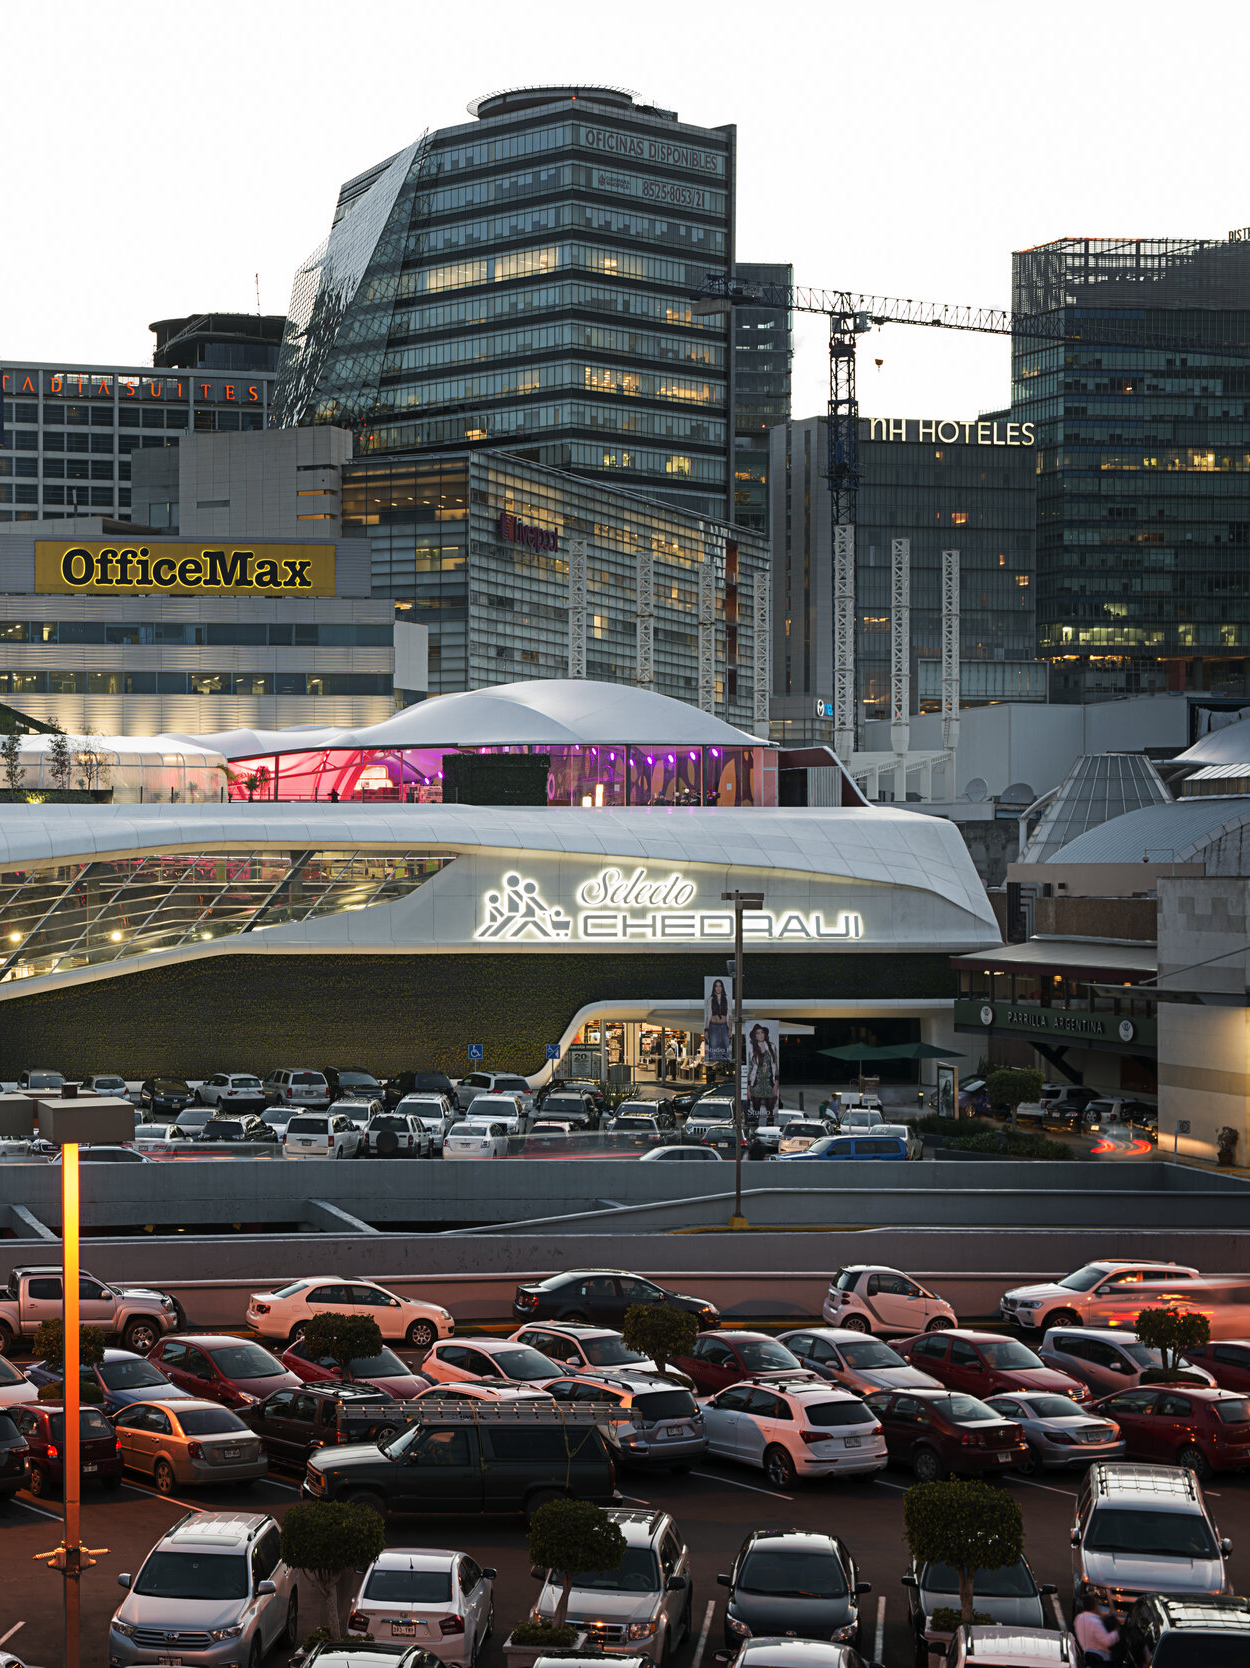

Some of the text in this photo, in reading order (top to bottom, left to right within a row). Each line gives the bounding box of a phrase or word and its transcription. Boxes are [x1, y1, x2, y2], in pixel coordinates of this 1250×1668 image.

[585, 129, 717, 172] OFICINAS DISPONIBLES
[126, 381, 258, 401] SUITES
[919, 420, 1035, 446] HOTELES
[61, 547, 312, 589] OfficeMax
[580, 868, 695, 906] Selecto
[582, 914, 862, 939] CHEDRAUI
[1007, 1011, 1103, 1034] PARRILLA ARGENTINA
